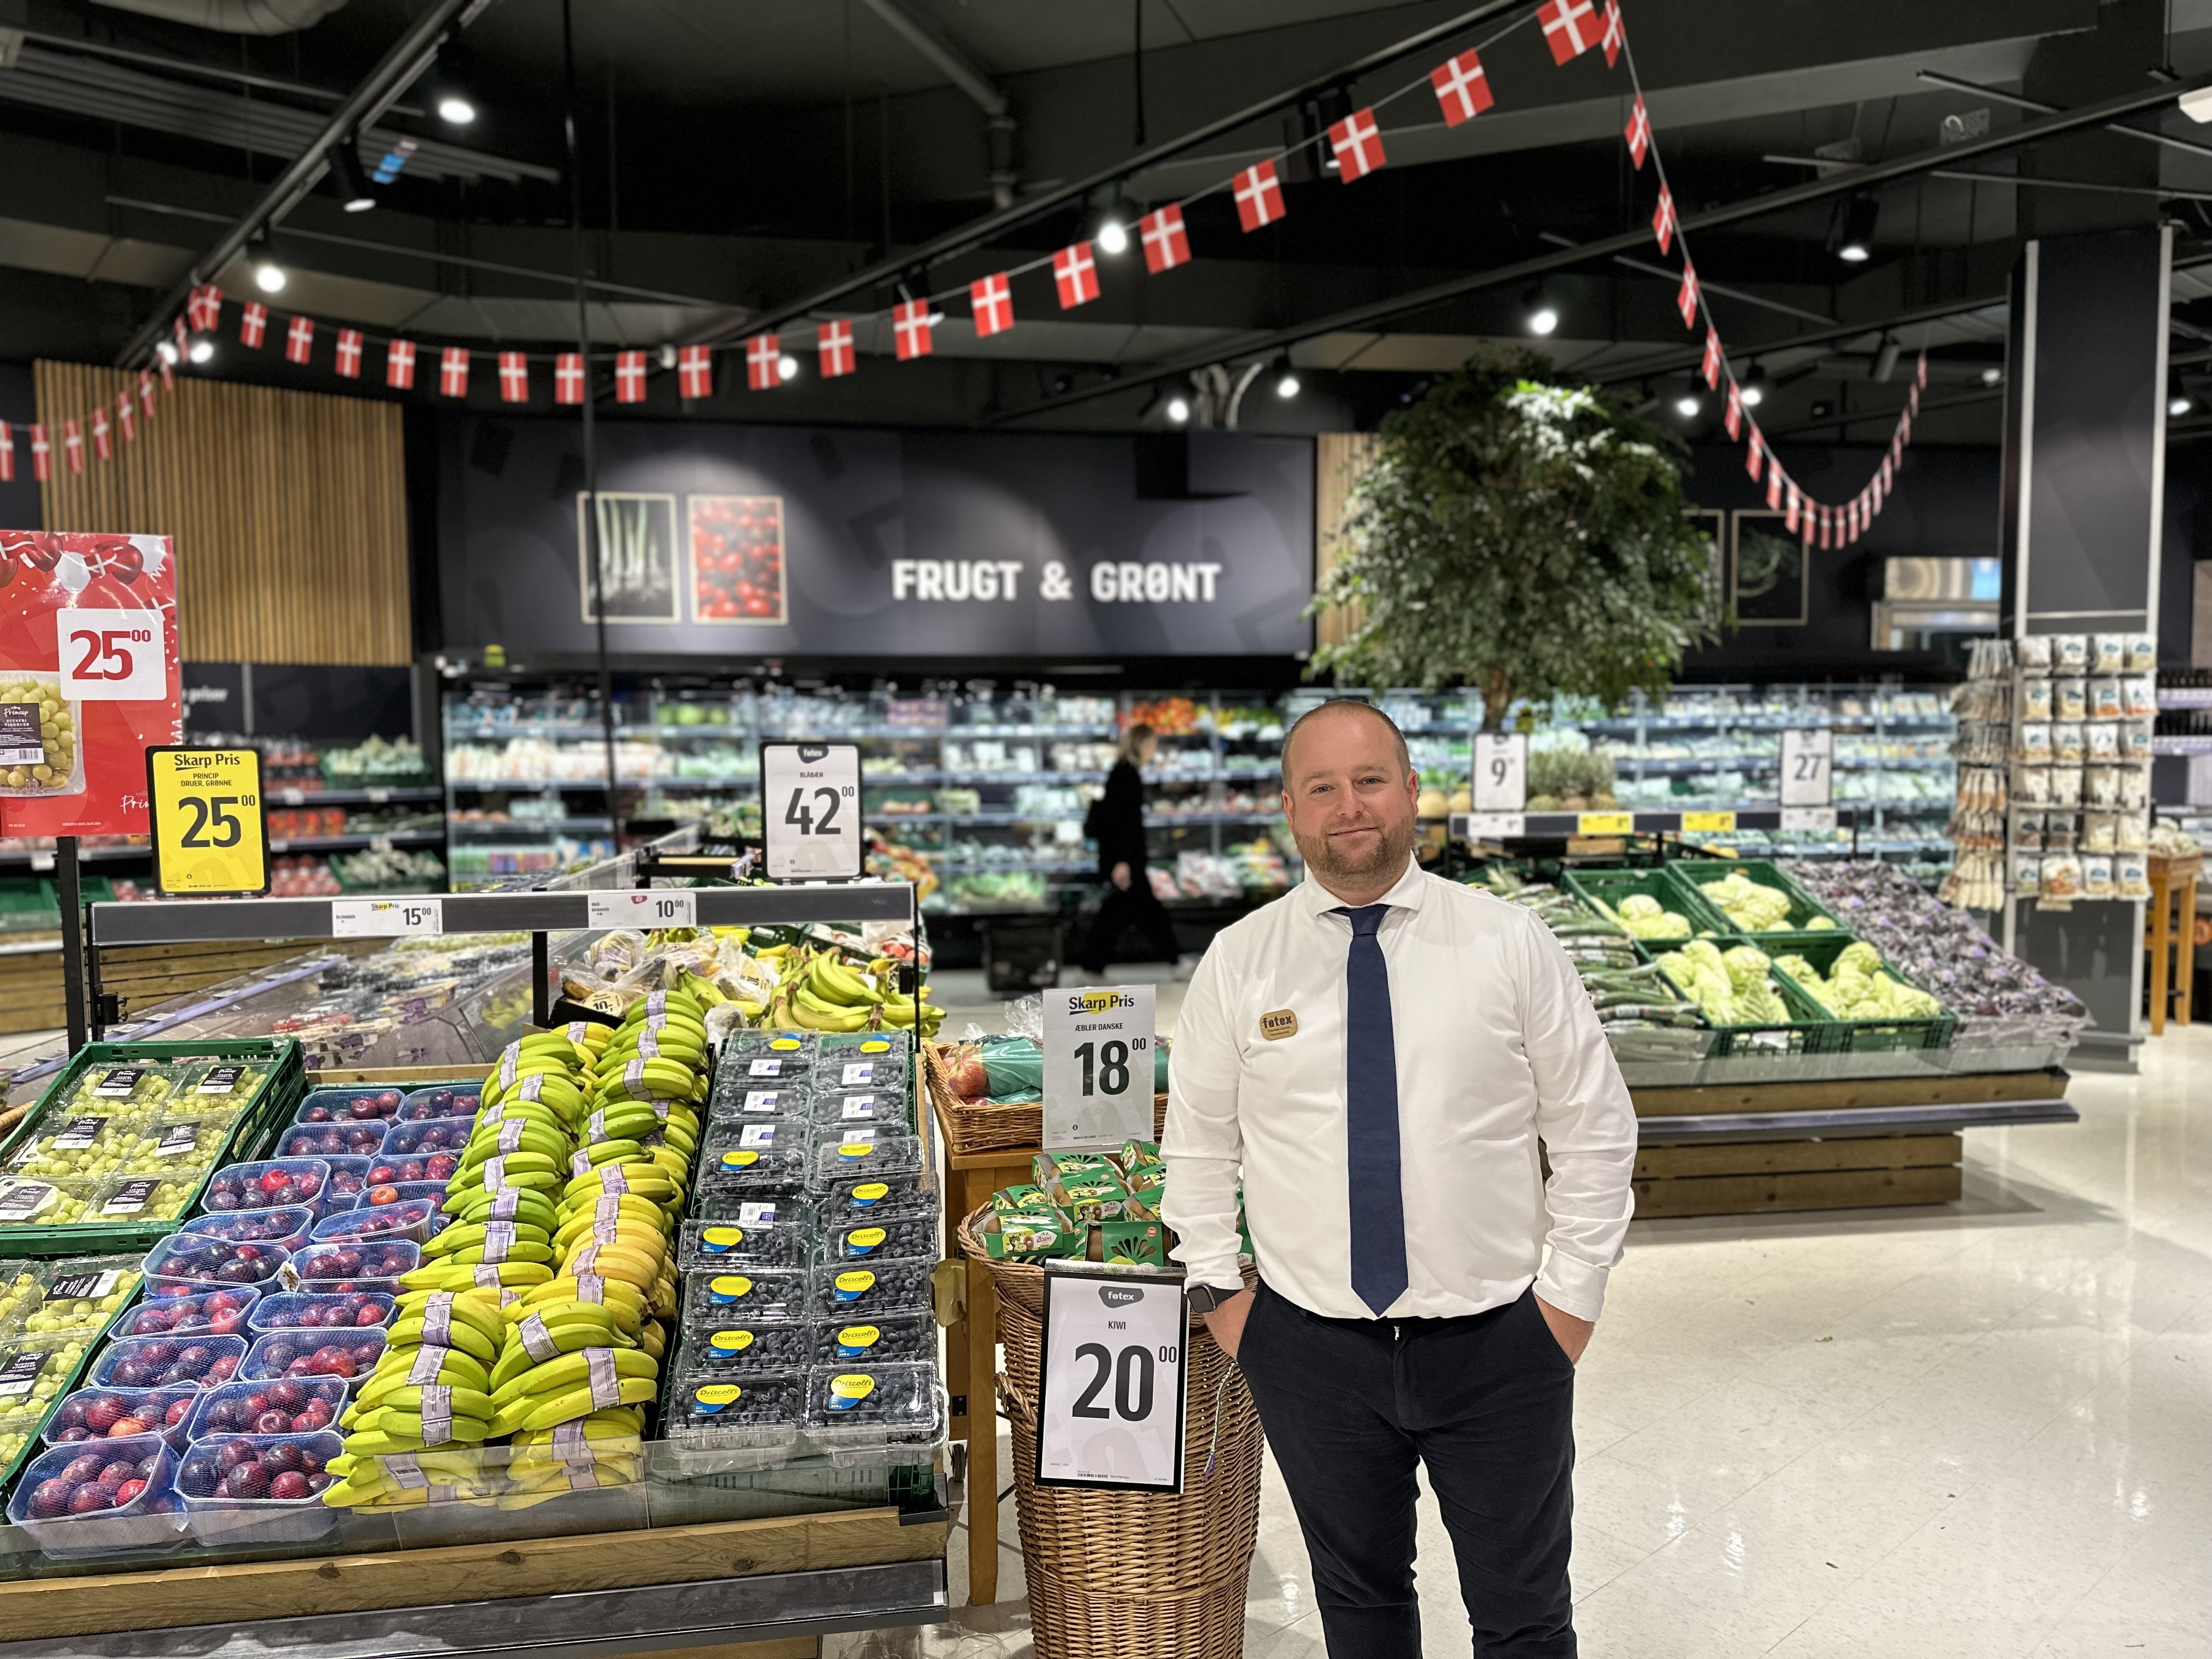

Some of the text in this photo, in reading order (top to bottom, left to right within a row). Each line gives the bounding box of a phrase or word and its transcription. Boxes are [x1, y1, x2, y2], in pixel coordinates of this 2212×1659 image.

[892, 560, 1222, 602] FRUGT & GRØNT
[71, 630, 151, 680] 25 00
[3, 708, 29, 718] Princip
[174, 753, 240, 768] Skarp Pris
[1794, 753, 1821, 780] 27
[1491, 758, 1506, 787] 9
[785, 786, 855, 835] 42 00
[178, 795, 256, 848] 25 00
[403, 908, 421, 926] 15
[656, 900, 674, 918] 10
[1069, 995, 1135, 1012] Skarp Pris
[1074, 1038, 1147, 1097] 18 00
[851, 1231, 883, 1239] Driscoll's
[838, 1274, 873, 1283] Driscoll's
[1107, 1291, 1135, 1301] føtex
[842, 1330, 877, 1338] Driscoll's
[1108, 1321, 1126, 1330] KIWI
[1072, 1342, 1177, 1422] 20 00
